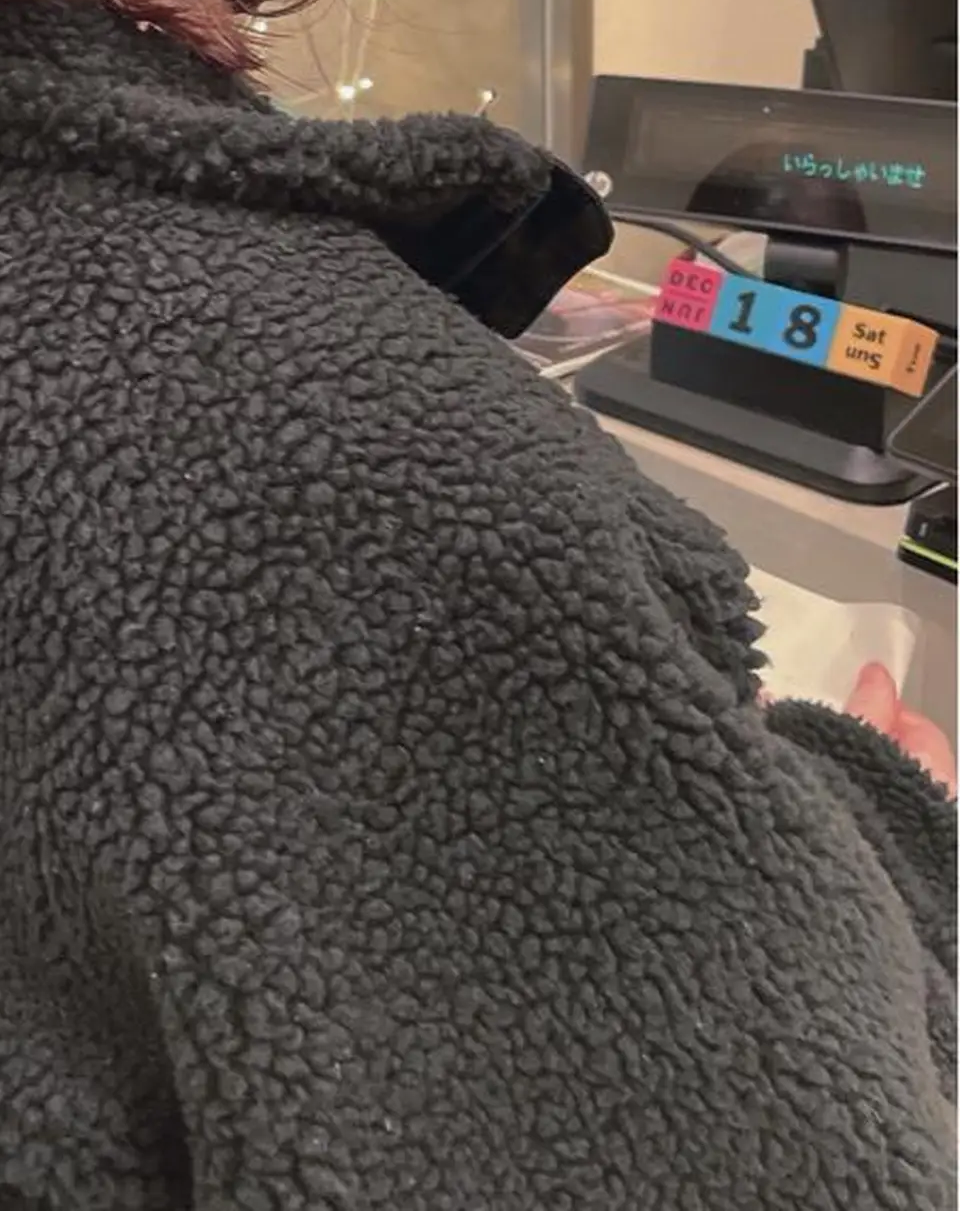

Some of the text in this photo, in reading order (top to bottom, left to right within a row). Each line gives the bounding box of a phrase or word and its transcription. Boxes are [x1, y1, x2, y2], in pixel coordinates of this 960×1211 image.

[783, 152, 926, 188] いらっしゃいませ
[852, 320, 888, 345] Sat
[844, 344, 883, 371] Sun
